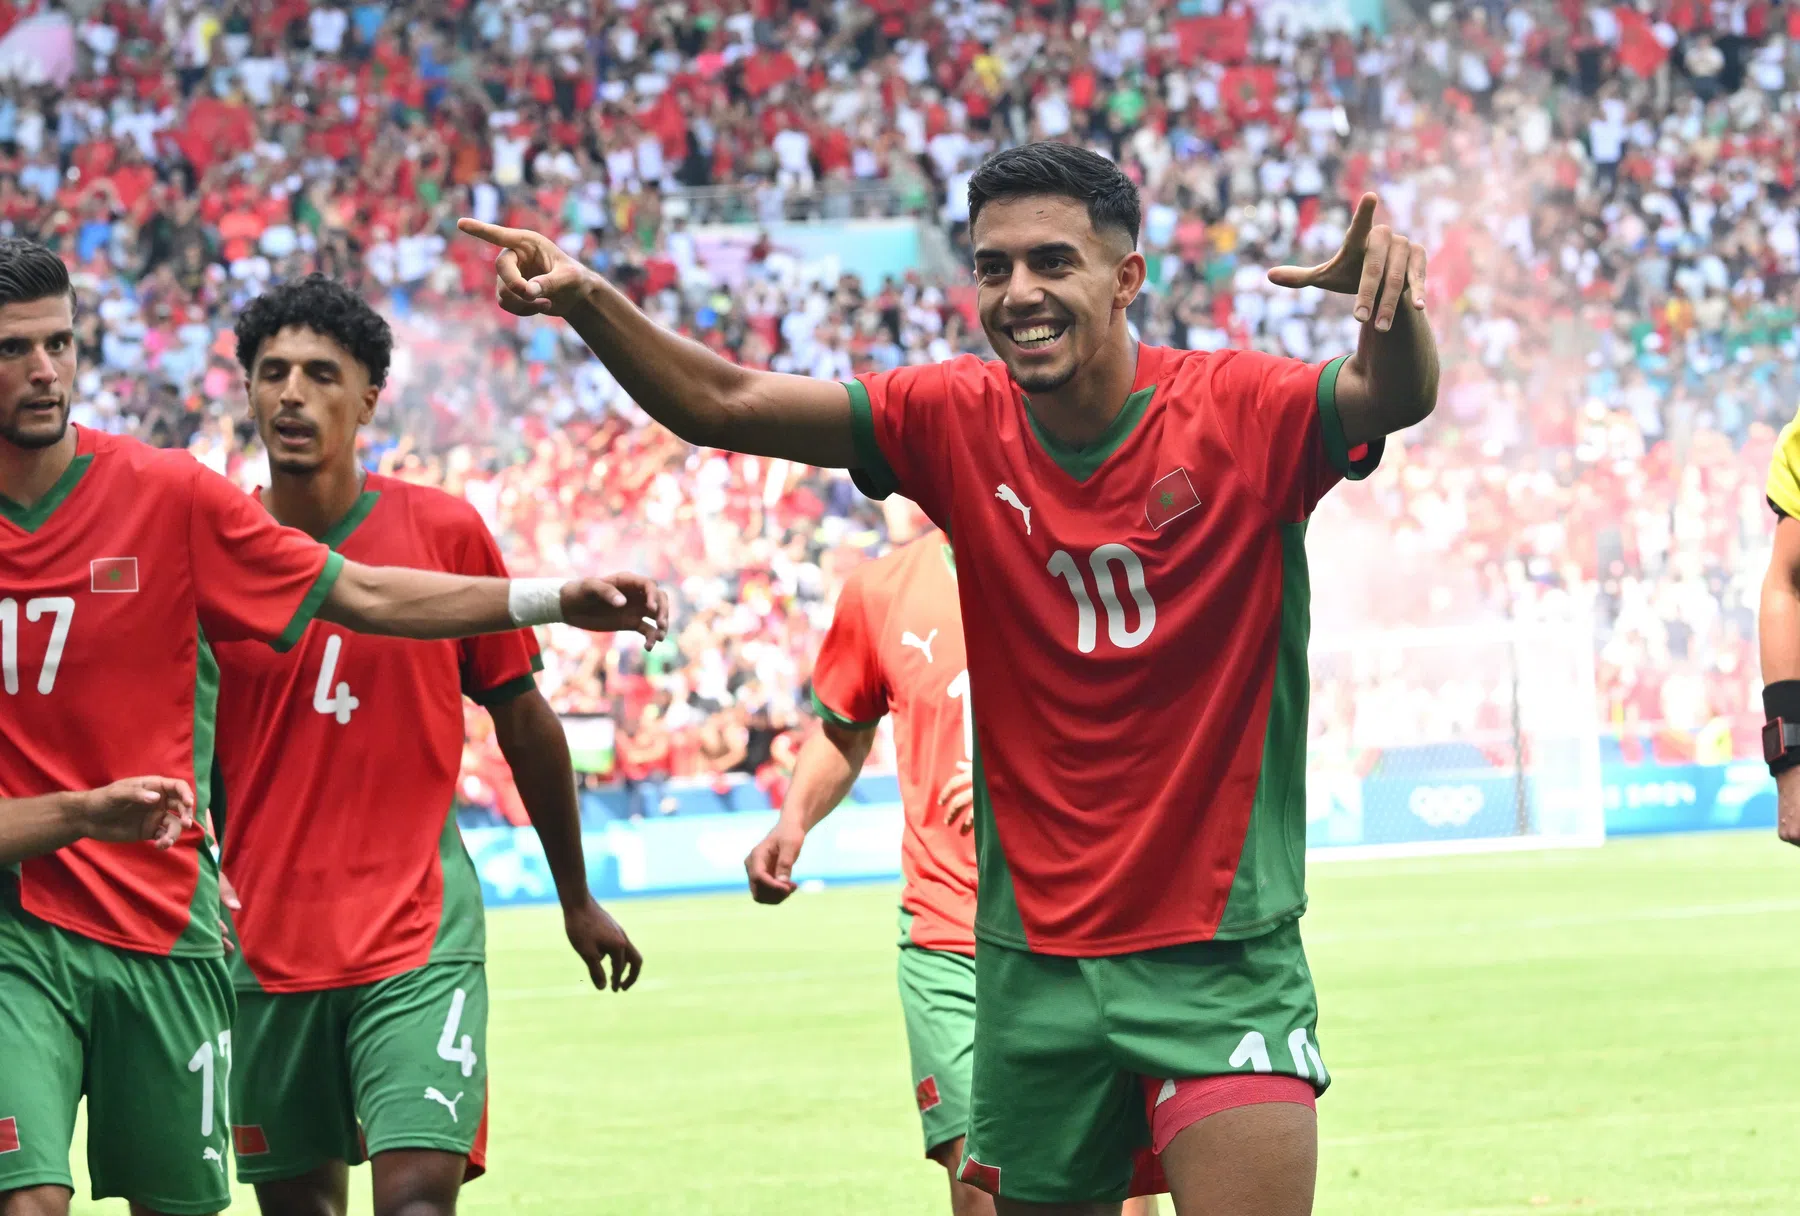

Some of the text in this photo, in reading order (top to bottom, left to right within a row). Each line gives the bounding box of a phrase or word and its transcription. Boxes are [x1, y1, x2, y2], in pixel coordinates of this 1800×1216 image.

[0, 596, 76, 696] 17
[1046, 543, 1157, 654] 10
[313, 634, 360, 725] 4
[436, 987, 478, 1078] 4
